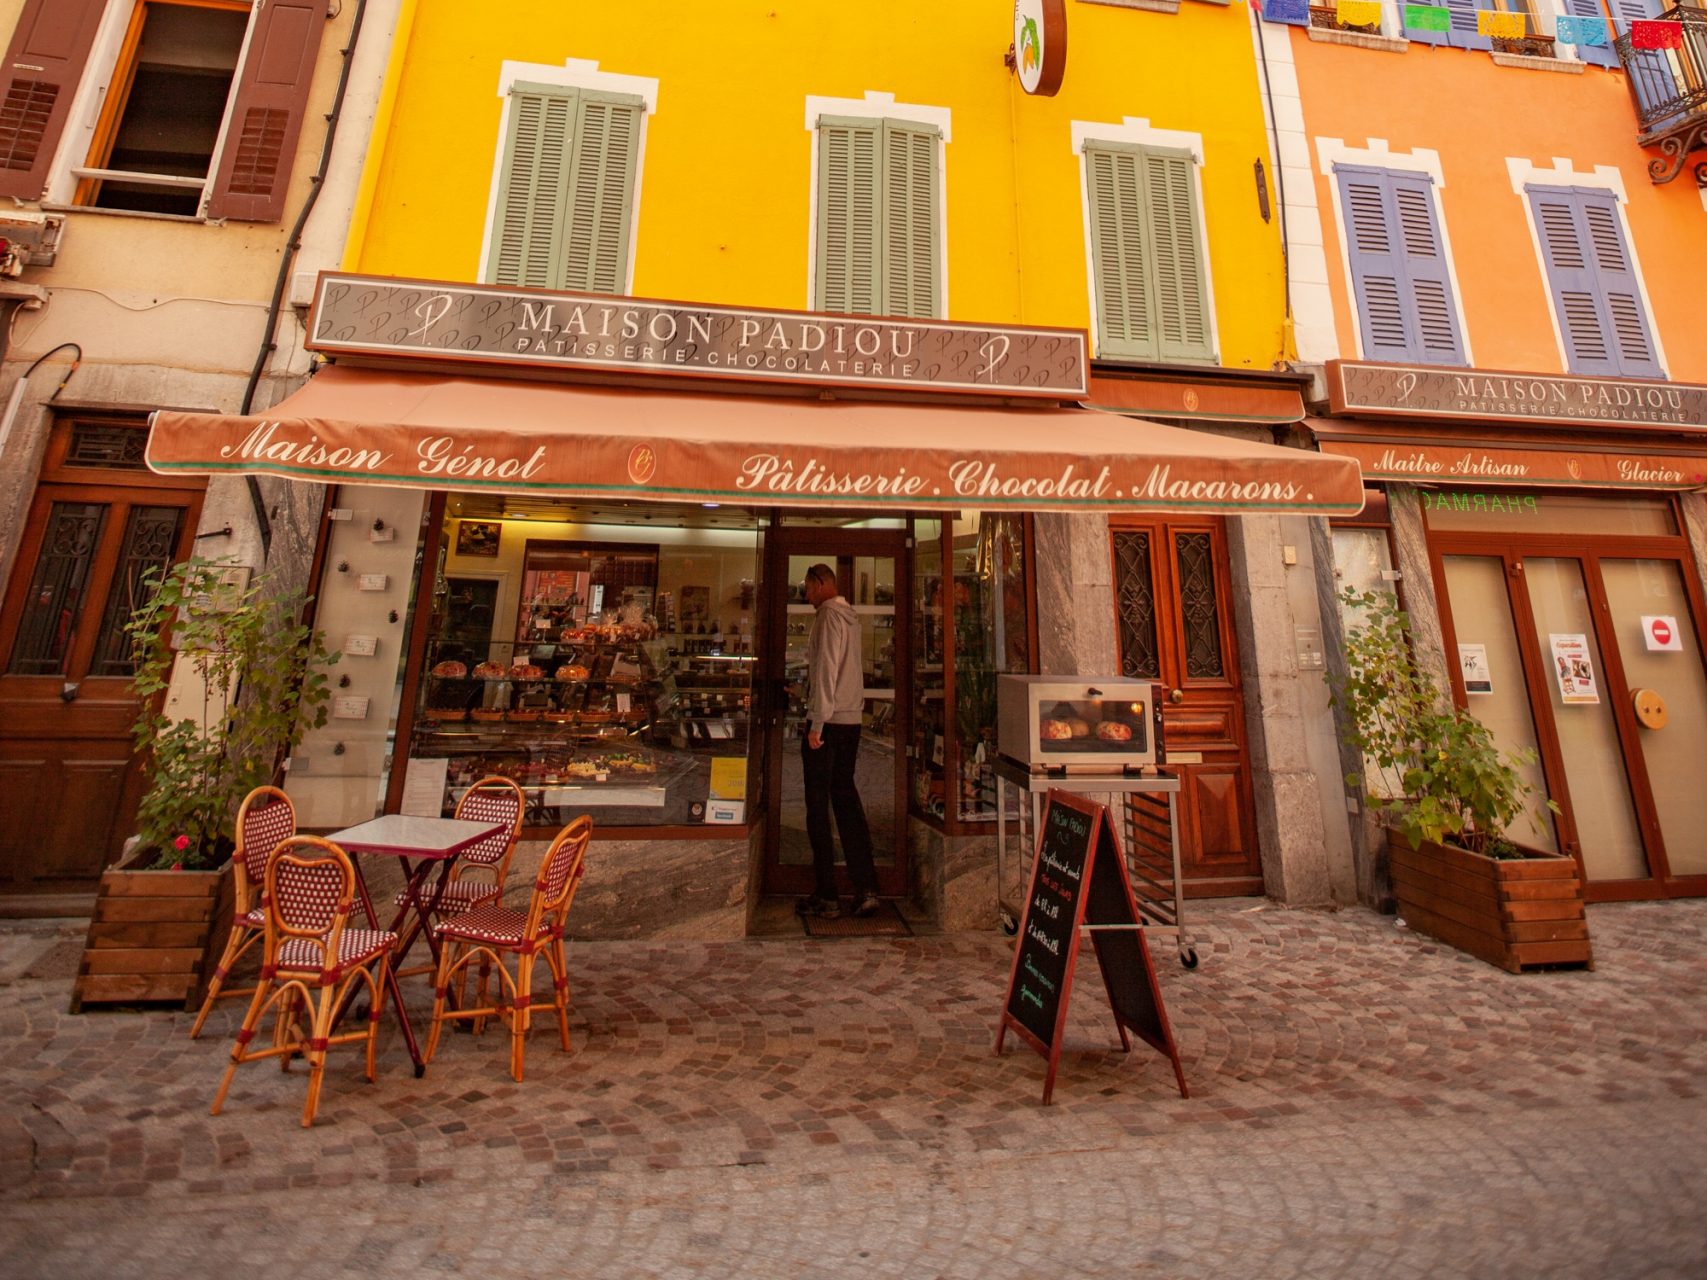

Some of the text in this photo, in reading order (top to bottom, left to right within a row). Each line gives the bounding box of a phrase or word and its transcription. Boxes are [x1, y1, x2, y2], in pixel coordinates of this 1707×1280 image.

[517, 302, 915, 358] MAISON PADIOU
[1455, 376, 1682, 409] MAISON PADIOU
[220, 421, 547, 480] Maison Génot
[1373, 449, 1530, 477] Maître Artisan
[736, 453, 1302, 501] Pâtisserie Chocolat Macarons
[1616, 459, 1685, 483] Glacier
